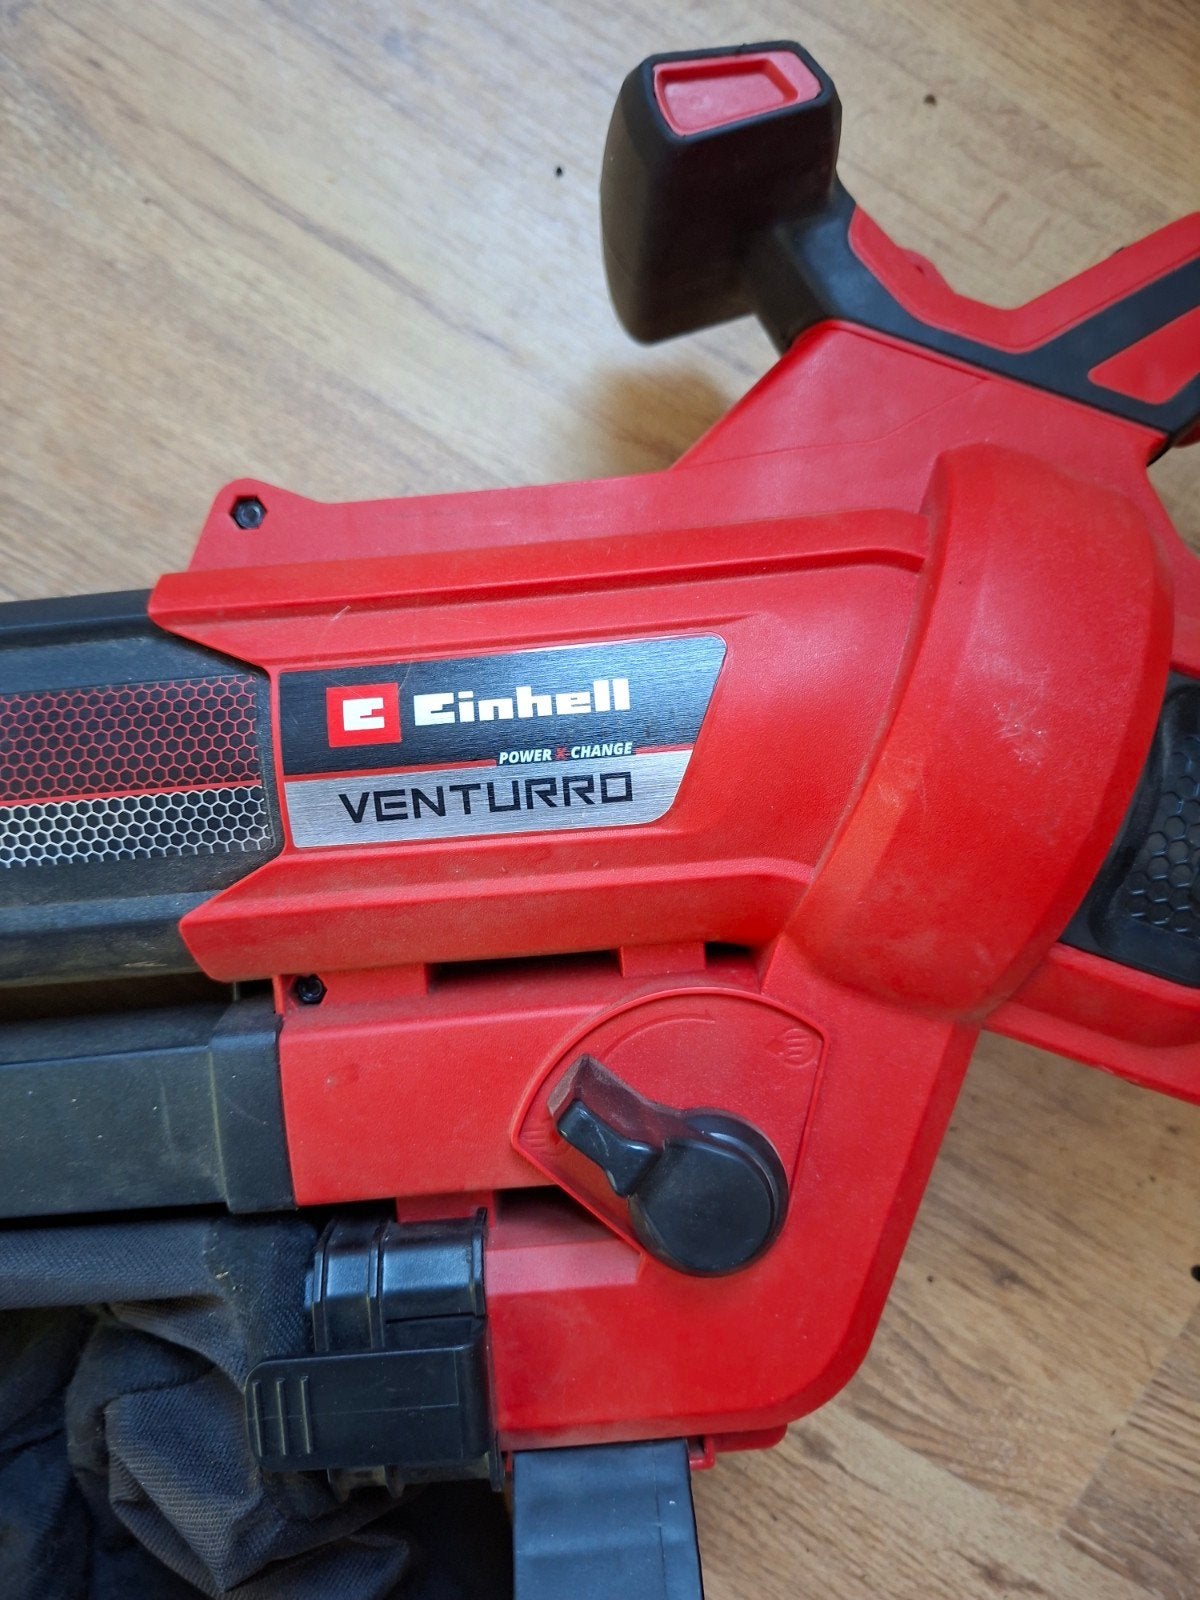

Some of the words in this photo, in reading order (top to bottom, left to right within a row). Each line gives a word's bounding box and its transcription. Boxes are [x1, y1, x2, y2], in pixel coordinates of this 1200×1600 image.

[413, 679, 630, 725] Einhell
[499, 749, 552, 765] POWER
[338, 772, 633, 823] VENTURRO
